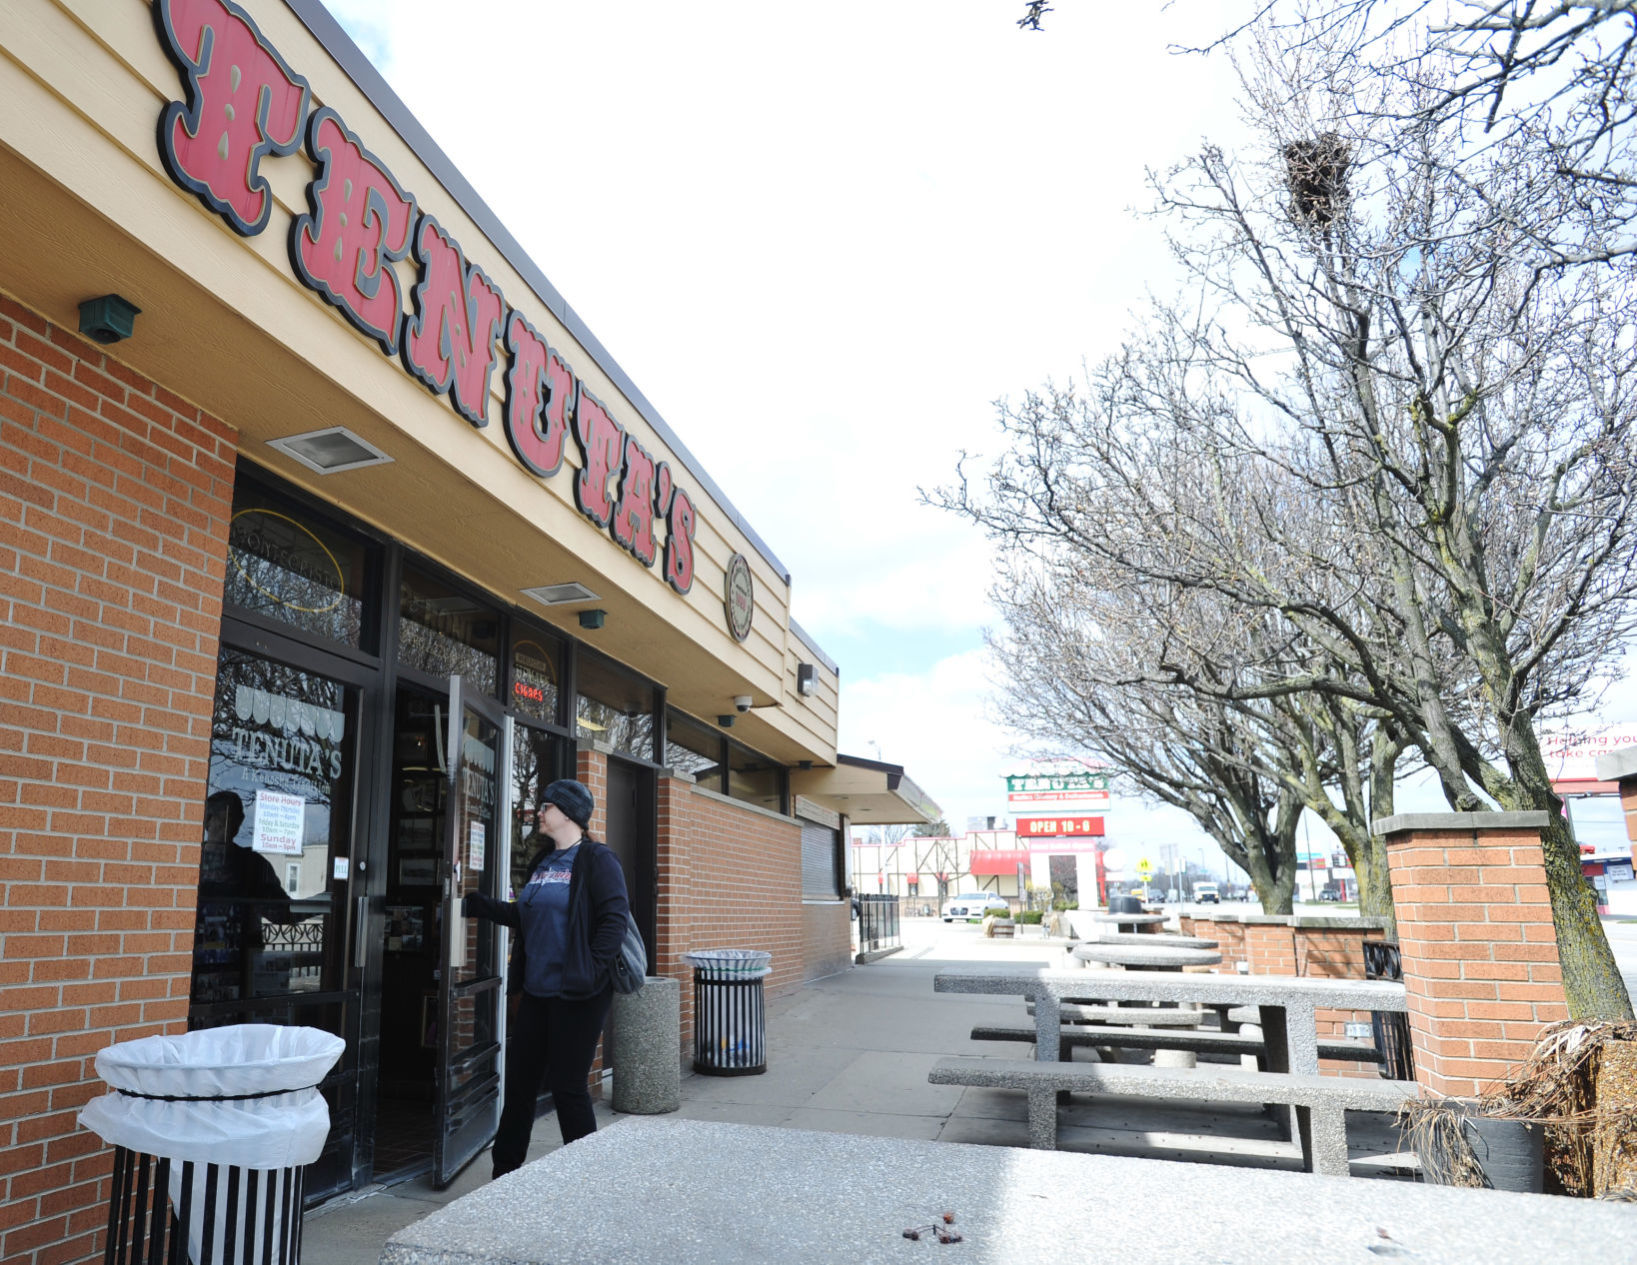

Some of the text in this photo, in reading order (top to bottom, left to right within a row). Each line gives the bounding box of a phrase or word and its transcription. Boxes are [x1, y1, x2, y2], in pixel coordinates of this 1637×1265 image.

[153, 0, 696, 596] TENUTA'S
[232, 726, 342, 779] TENUTA'S
[1550, 749, 1584, 758] take
[260, 792, 302, 807] Store Hours
[1030, 821, 1057, 832] OPEN
[1061, 820, 1074, 832] 10
[260, 833, 297, 846] Sunday
